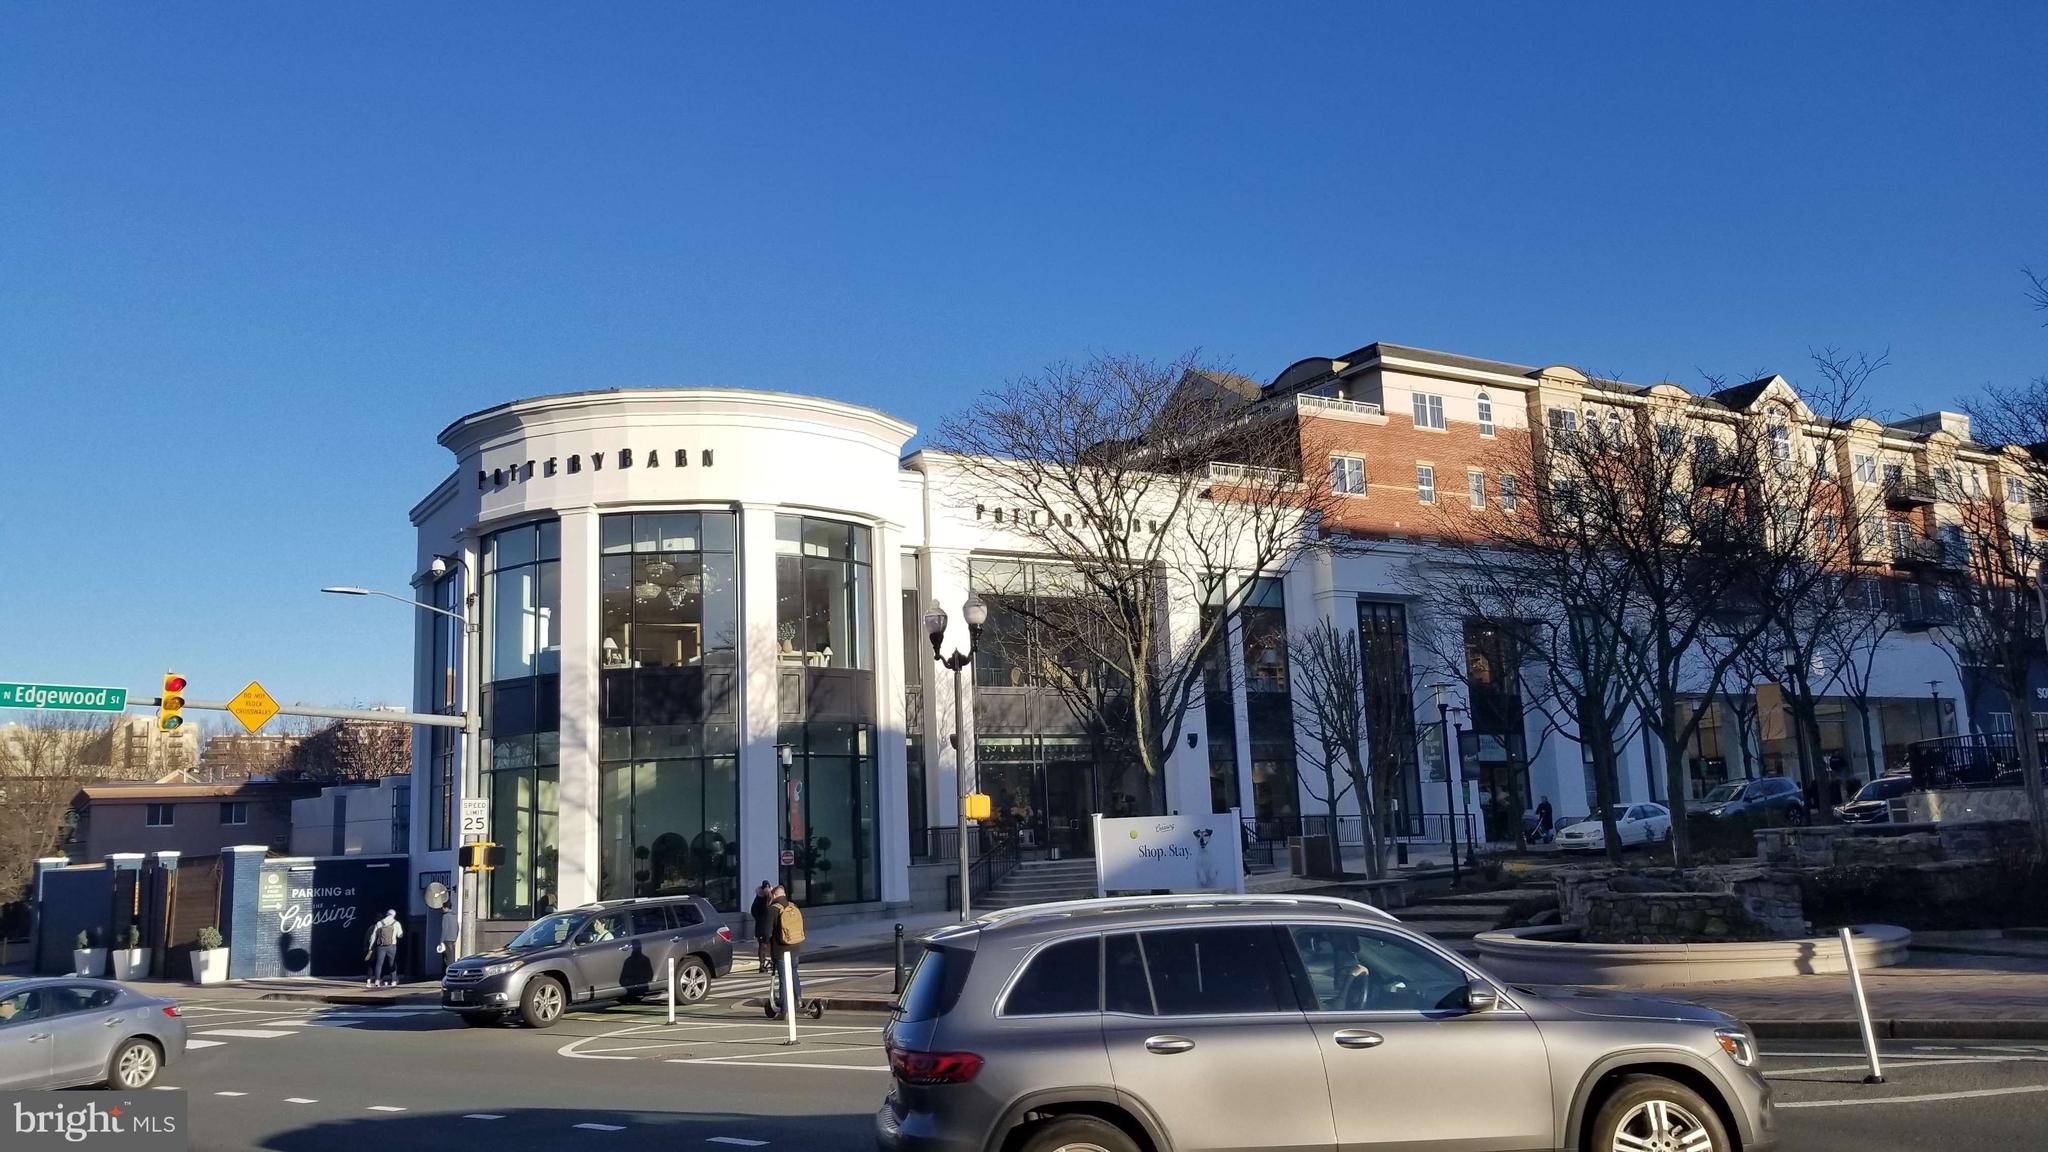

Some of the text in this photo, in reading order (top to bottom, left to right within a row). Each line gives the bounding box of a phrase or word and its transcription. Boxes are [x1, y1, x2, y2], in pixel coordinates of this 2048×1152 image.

[3, 686, 120, 708] N Edgewood St
[464, 817, 485, 831] 25
[1138, 843, 1193, 861] Shop. Stay.
[291, 887, 342, 899] PARKING
[344, 887, 356, 896] at
[279, 904, 357, 933] Crossing
